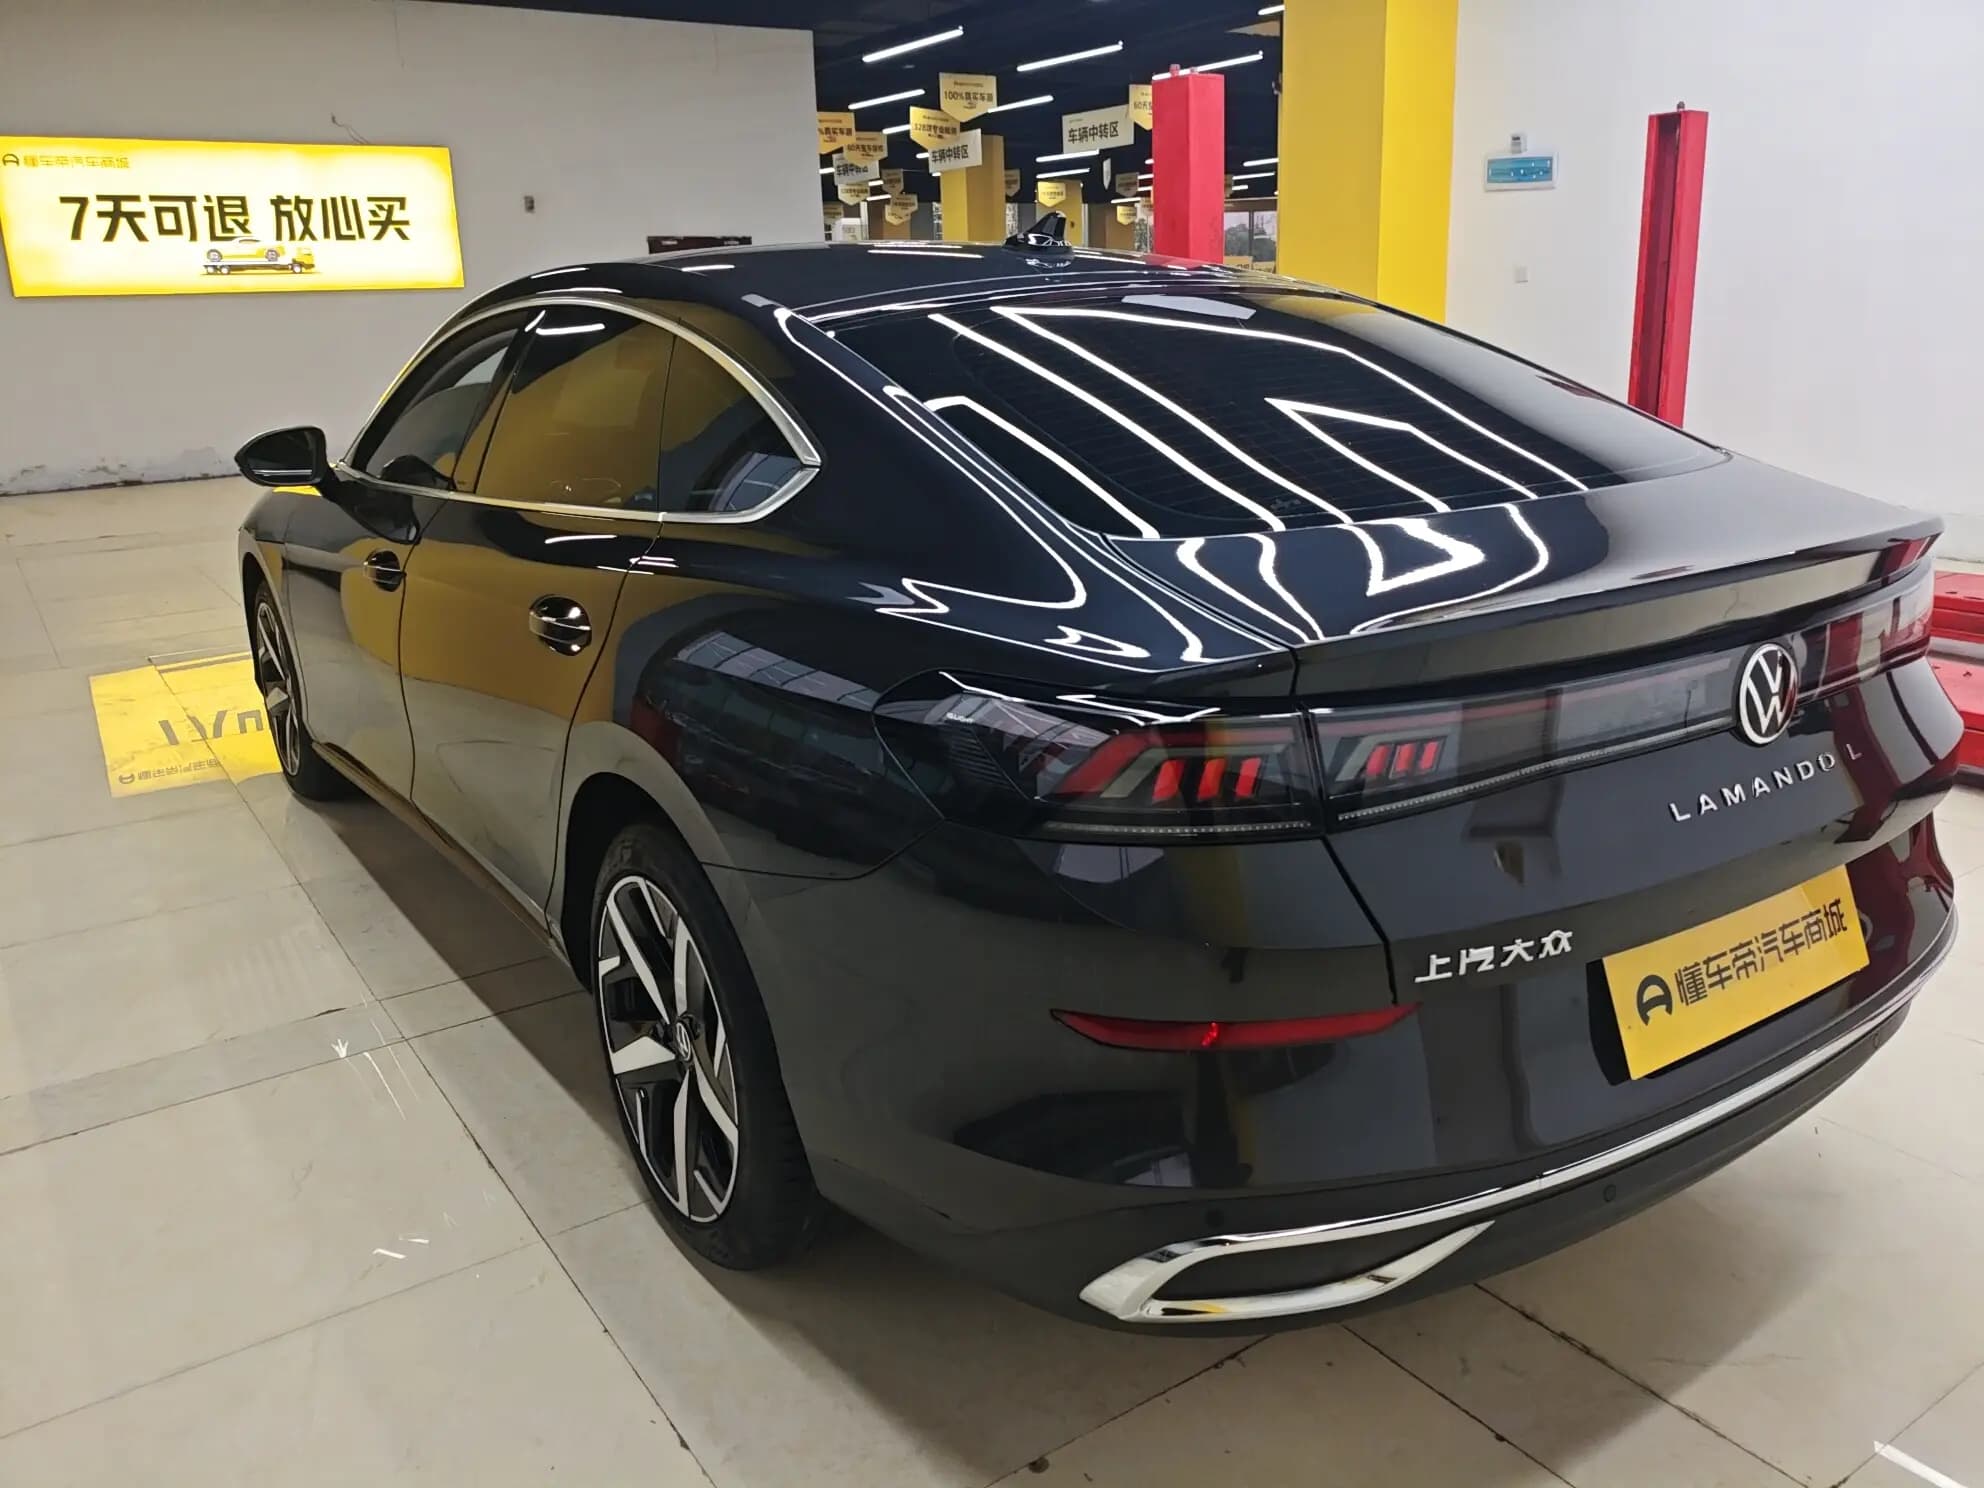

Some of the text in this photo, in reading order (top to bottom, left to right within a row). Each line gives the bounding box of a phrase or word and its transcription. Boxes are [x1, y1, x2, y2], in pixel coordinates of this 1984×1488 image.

[932, 145, 968, 162] 车辆中转区
[1068, 121, 1119, 144] 车辆中转区
[59, 194, 410, 242] 7天可退 放心买
[1669, 743, 1862, 822] LAMANDO L
[1414, 929, 1573, 983] 上汽大众
[1673, 898, 1847, 1007] 懂车帝汽车商城
